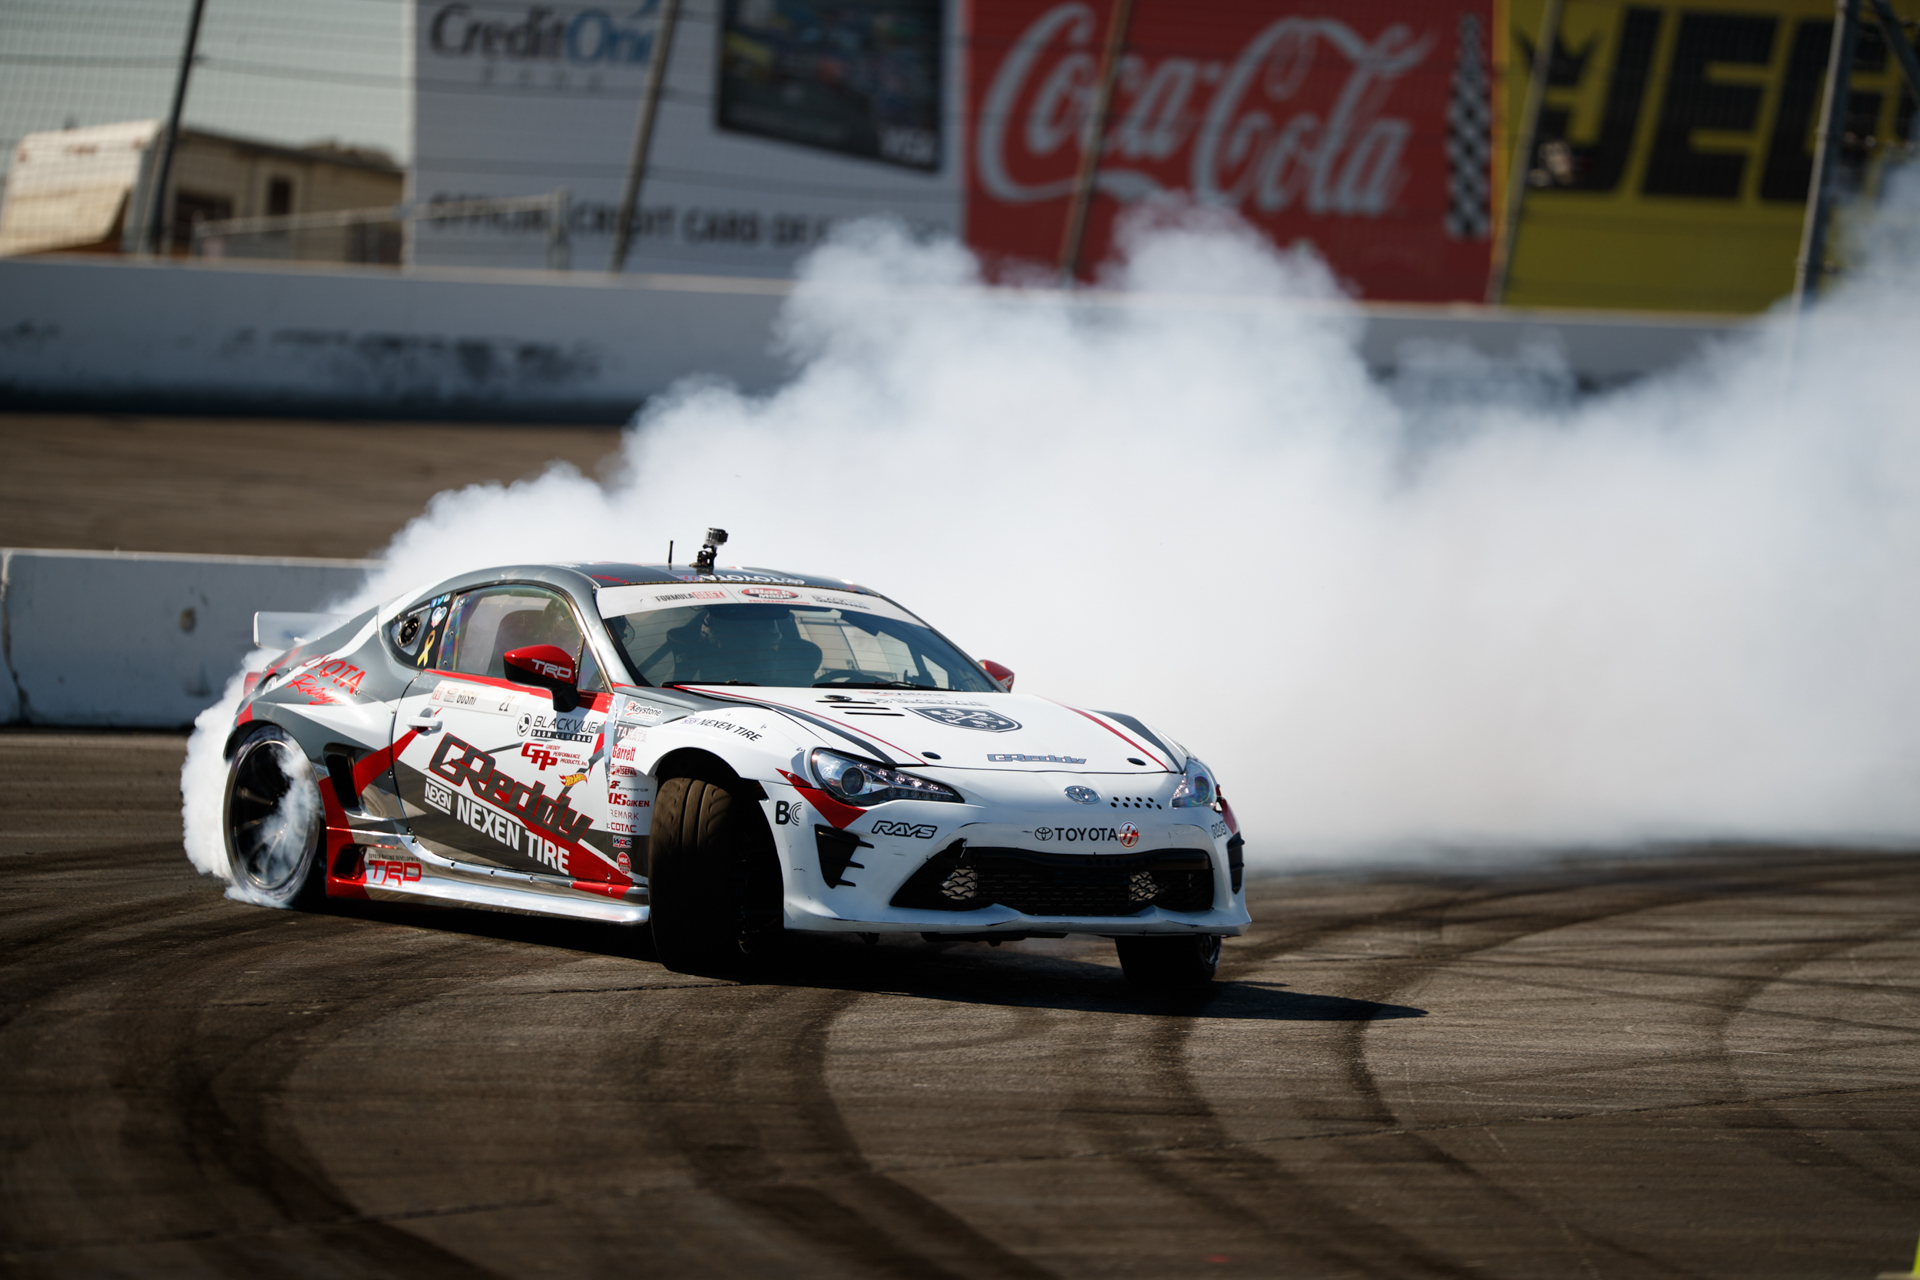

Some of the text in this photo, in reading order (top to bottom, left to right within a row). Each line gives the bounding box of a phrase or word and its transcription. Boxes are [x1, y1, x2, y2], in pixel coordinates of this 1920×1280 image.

[655, 593, 695, 602] FORMULA
[531, 658, 572, 679] TRD
[630, 703, 662, 717] Keystone
[533, 715, 598, 734] BLACKVUE
[698, 719, 736, 731] NEXEN
[733, 726, 763, 741] TIRE
[532, 730, 592, 743] DASH CAMERAS
[612, 743, 636, 762] Garrett
[987, 753, 1087, 764] GReddy
[429, 732, 594, 844] GReddy
[608, 792, 627, 806] OS
[610, 809, 639, 820] REMARK
[424, 782, 570, 876] NEXEN NEXEN TIRE
[871, 820, 937, 839] RAYS
[1054, 827, 1118, 841] TOYOTA
[368, 860, 422, 887] TRD
